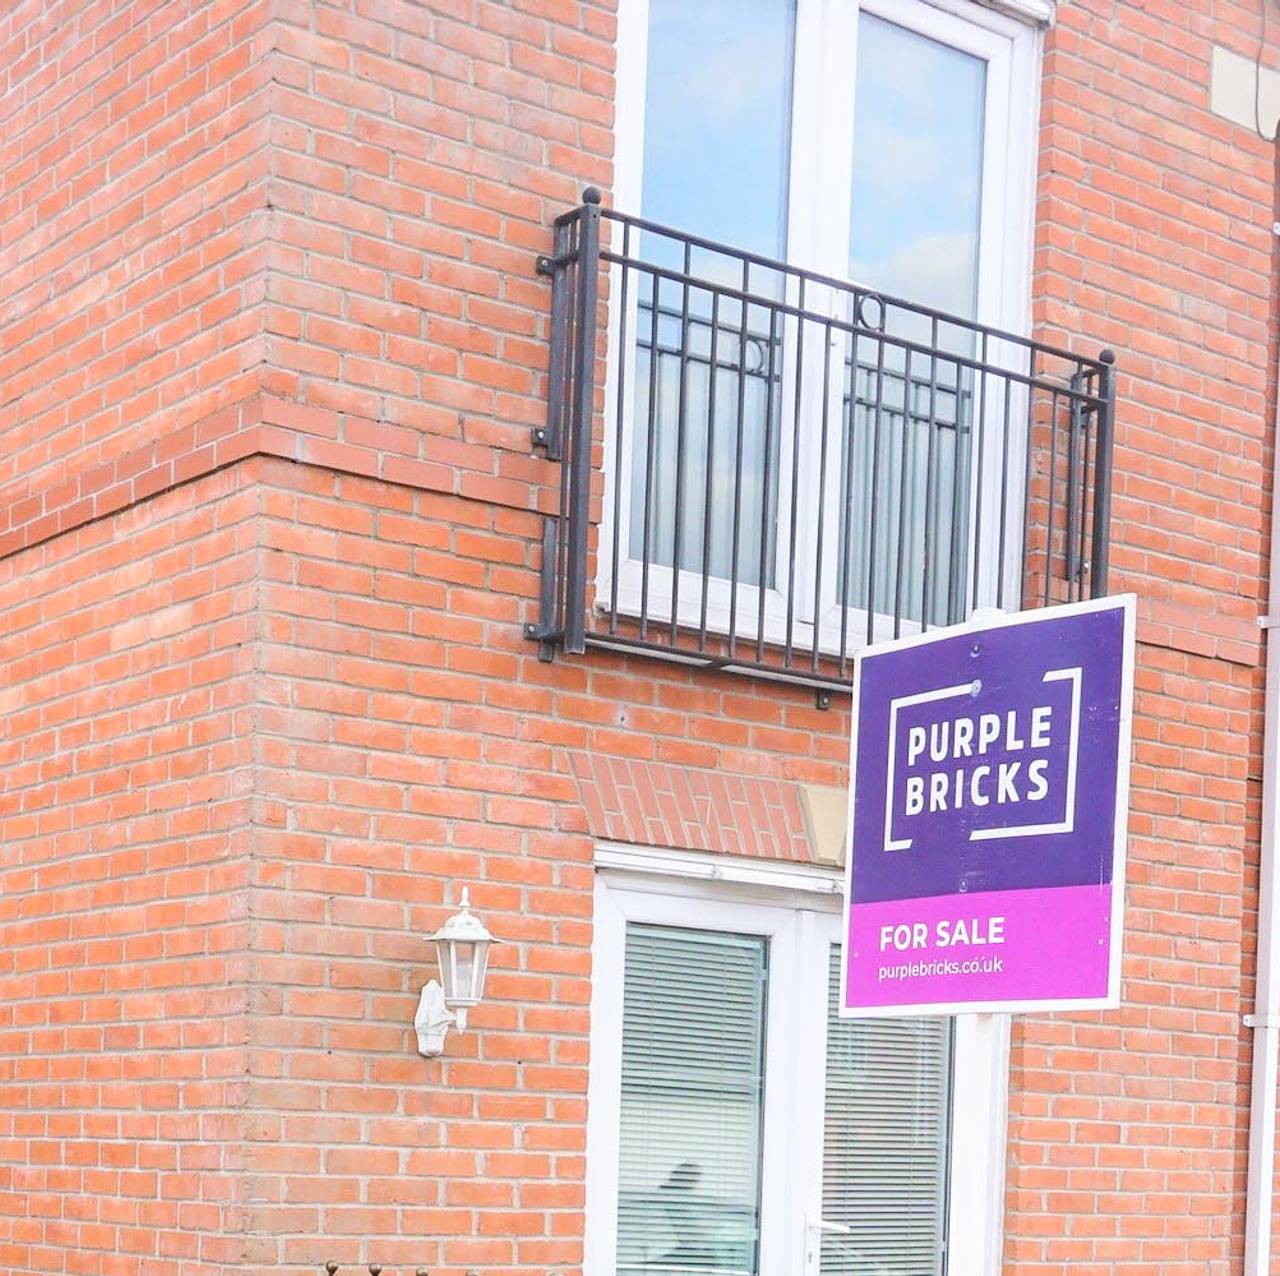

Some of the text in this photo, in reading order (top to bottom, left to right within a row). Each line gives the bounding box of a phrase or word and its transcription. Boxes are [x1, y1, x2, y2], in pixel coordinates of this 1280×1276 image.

[908, 706, 1052, 766] PURPLE
[905, 759, 1049, 816] BRICKS
[879, 916, 1005, 952] FOR SALE
[878, 955, 1003, 981] purplebricks.co.uk
